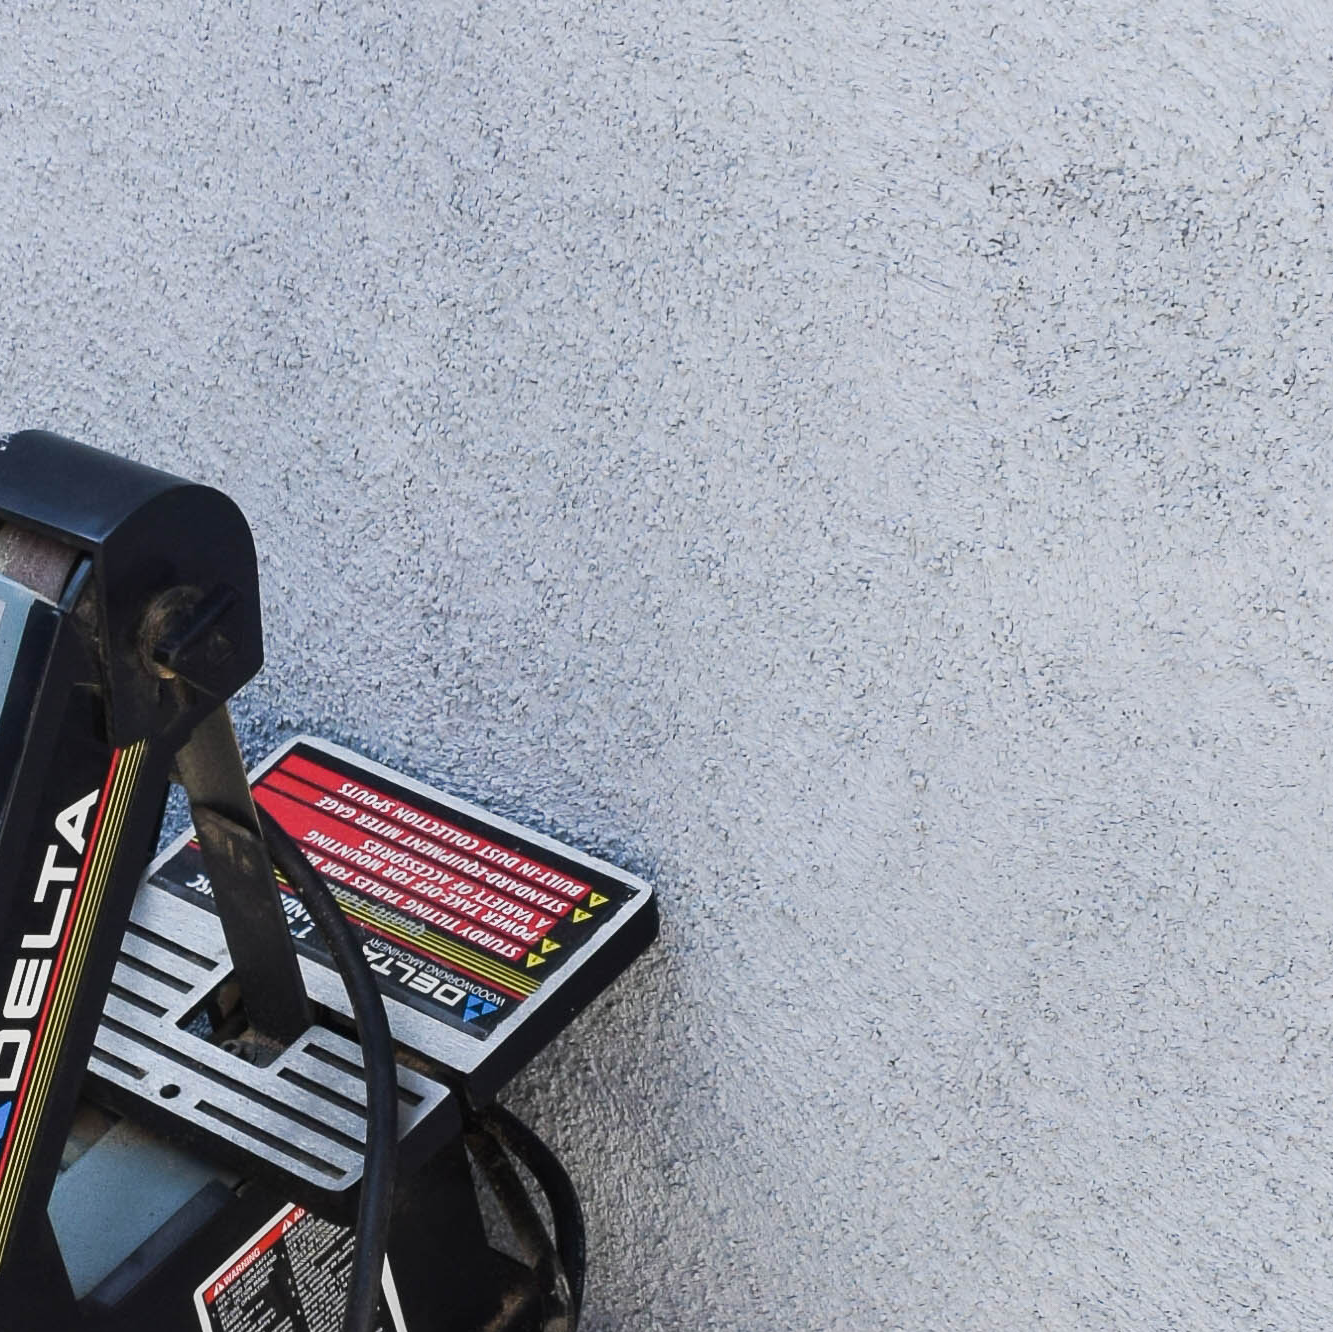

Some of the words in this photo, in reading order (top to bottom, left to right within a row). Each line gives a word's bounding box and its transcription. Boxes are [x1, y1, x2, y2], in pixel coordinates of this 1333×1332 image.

[314, 796, 356, 818] GAGE
[337, 783, 396, 812] SPOUTS
[354, 813, 404, 840] MITER
[391, 807, 479, 850] COLLECTION
[303, 830, 385, 871] MOUNTING
[358, 840, 454, 884] ACCESSORIES
[475, 845, 520, 868] DUST
[320, 861, 354, 880] FOR
[382, 865, 416, 885] FOR
[398, 835, 568, 912] STANDARD-EQUIPMENT
[516, 862, 585, 896] BUILT-IN
[349, 876, 404, 904] TABLES
[410, 880, 482, 917] TAKE-OFF
[448, 881, 473, 894] OF
[400, 899, 460, 931] TILTING
[470, 889, 534, 924] VARIETY
[481, 910, 538, 941] POWER
[535, 917, 552, 928] A
[366, 938, 426, 969] MACHINERY
[456, 926, 521, 957] STURDY
[424, 964, 506, 1006] WOODWORKING
[223, 1247, 260, 1285] WARNING
